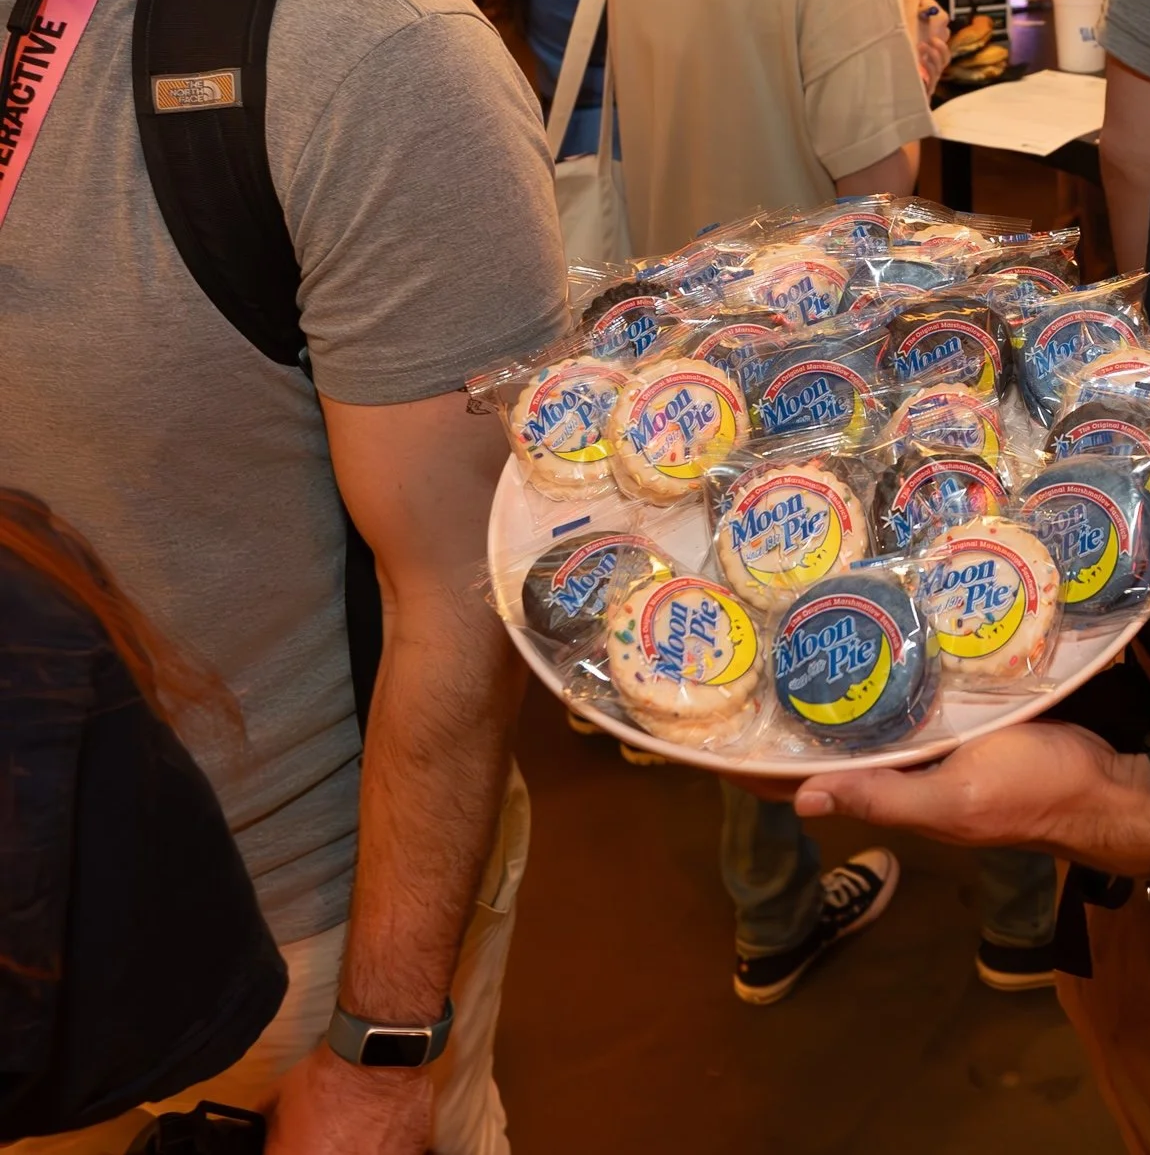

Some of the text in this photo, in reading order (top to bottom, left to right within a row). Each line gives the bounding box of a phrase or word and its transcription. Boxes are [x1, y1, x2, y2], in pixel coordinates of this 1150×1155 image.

[0, 16, 68, 180] ERACTIVE
[178, 95, 204, 103] FACE
[781, 365, 806, 381] Original
[806, 364, 849, 377] Marshmallow
[895, 336, 962, 379] Moon
[1035, 335, 1083, 380] Moo
[629, 389, 692, 454] Moon
[680, 402, 716, 445] Pie
[763, 377, 830, 428] Moon
[811, 395, 848, 424] Pie
[1078, 425, 1091, 435] The
[1092, 422, 1120, 430] Original
[784, 476, 826, 493] Marshmallow
[828, 488, 848, 521] Sandwich
[1039, 486, 1067, 502] Original
[1067, 486, 1110, 508] Marshmallow
[1110, 505, 1128, 541] Sandwich
[729, 493, 804, 551] Moon
[782, 509, 826, 552] Pie
[1061, 524, 1104, 562] Pie
[558, 553, 618, 617] Moon
[919, 560, 995, 597] Moon
[963, 583, 1009, 618] Pie
[690, 600, 718, 647] Pie
[833, 597, 880, 618] Marshmallow
[655, 602, 688, 684] Moon
[776, 615, 855, 678] Moon
[826, 640, 875, 684] Pie
